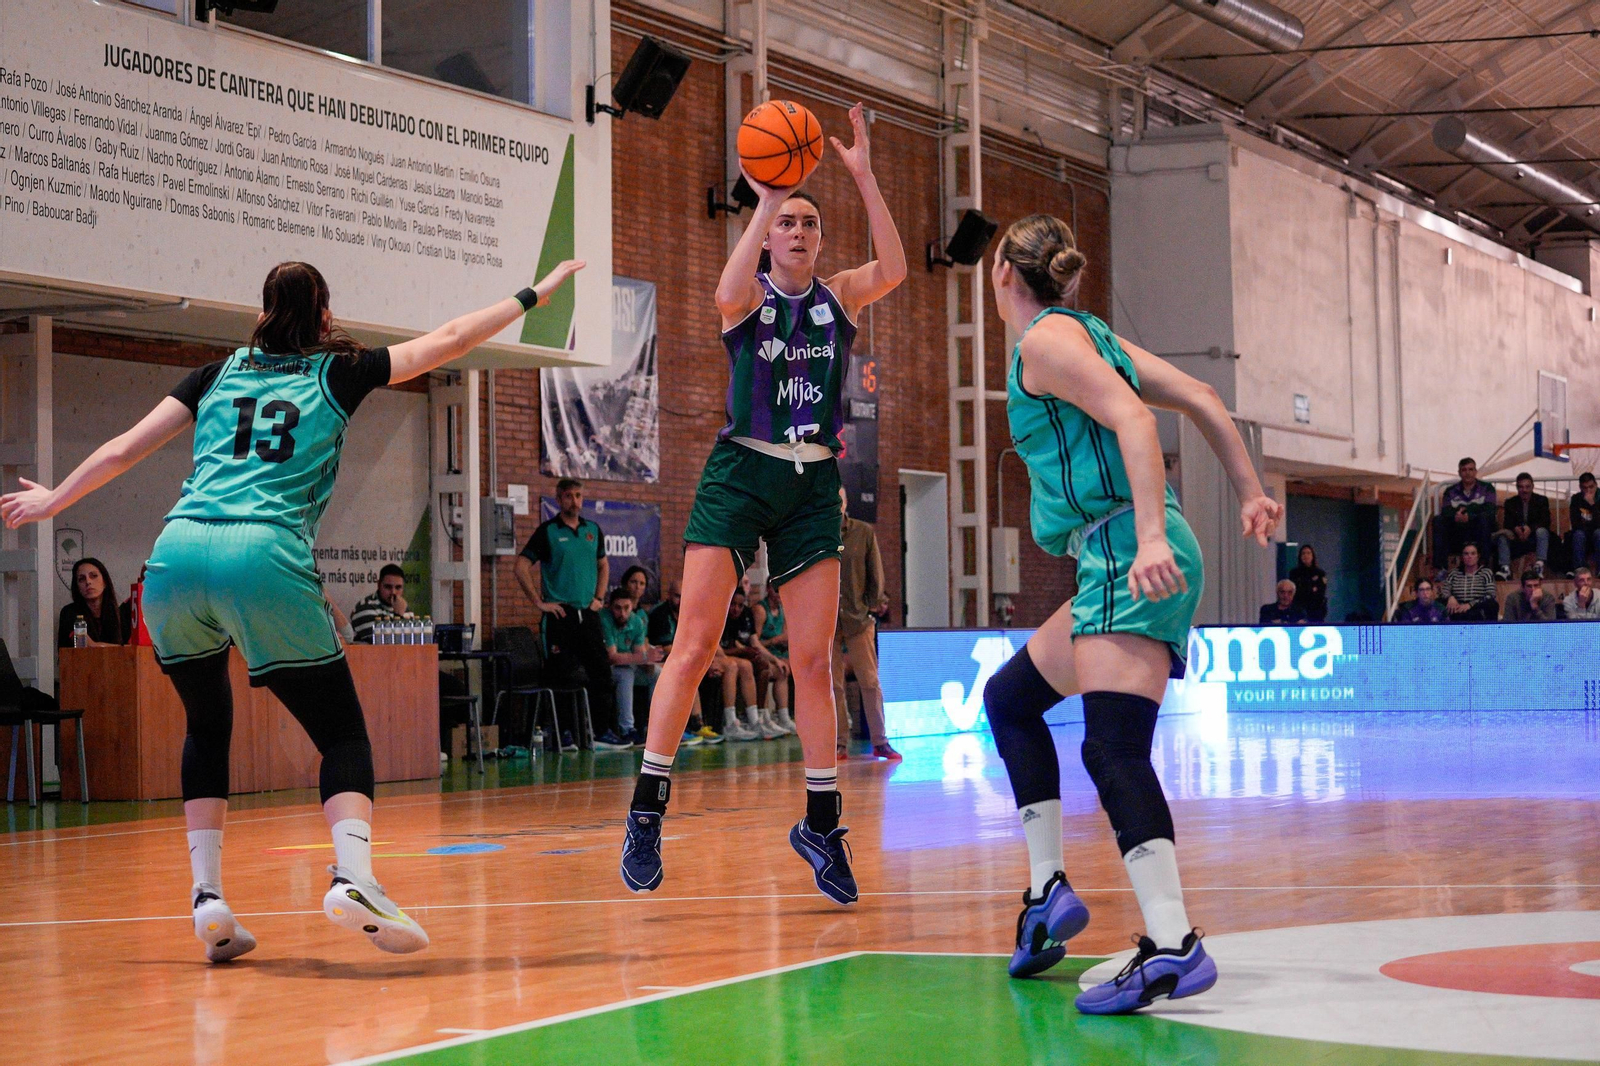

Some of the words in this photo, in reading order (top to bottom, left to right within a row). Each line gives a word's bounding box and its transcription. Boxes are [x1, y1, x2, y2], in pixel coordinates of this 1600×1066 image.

[0, 67, 21, 86] Rafa
[24, 72, 47, 92] Pozo
[55, 80, 76, 99] José
[79, 85, 111, 106] Antonio
[114, 92, 151, 115] Sánchez
[152, 101, 182, 121] Aranda
[190, 106, 212, 130] Ángel
[214, 112, 244, 135] Álvarez
[268, 126, 290, 145] Pedro
[325, 139, 356, 158] Armando
[358, 146, 384, 165] Nogués
[390, 154, 406, 168] Juan
[408, 157, 432, 174] Antonio
[480, 171, 500, 188] Osuna
[103, 44, 192, 84] JUGADORES
[197, 65, 216, 90] DE
[220, 71, 283, 105] CANTERA
[287, 88, 314, 112] QUE
[318, 95, 346, 120] HAN
[350, 102, 415, 135] DEBUTADO
[418, 118, 443, 141] CON
[446, 124, 459, 145] EL
[462, 128, 505, 155] PRIMER
[509, 139, 548, 165] EQUIPO
[0, 95, 29, 114] ntonio
[31, 99, 66, 123] Villegas
[74, 108, 115, 131] Fernando
[116, 117, 137, 136] Vidal
[145, 125, 177, 144] Juanma
[180, 130, 208, 150] Gómez
[214, 138, 234, 156] Jordi
[235, 142, 255, 160] Grau
[261, 148, 279, 164] Juan
[280, 152, 308, 171] Antonio
[310, 157, 328, 175] Rosa
[334, 163, 351, 179] José
[352, 166, 374, 186] Miguel
[376, 171, 408, 190] Cárdenas
[413, 180, 432, 195] Jesús
[433, 183, 455, 200] Lázaro
[460, 188, 483, 205] Manolo
[28, 123, 54, 143] Curro
[56, 126, 86, 150] Ávalos
[94, 136, 117, 159] Gaby
[120, 141, 139, 160] Ruiz
[147, 147, 174, 166] Nacho
[176, 152, 217, 176] Rodríguez
[224, 163, 254, 182] Antonio
[255, 166, 279, 187] Álamo
[286, 175, 314, 194] Ernesto
[316, 180, 345, 199] Serrano
[350, 187, 368, 203] Richi
[399, 196, 416, 213] Yuse
[444, 205, 463, 224] Fredy
[464, 209, 495, 227] Navarrete
[5, 195, 24, 214] Pino
[32, 200, 74, 221] Baboucar
[76, 207, 97, 229] Badji
[10, 169, 44, 192] Ognjen
[47, 176, 81, 197] Kuzmic
[90, 184, 120, 204] Maodo
[123, 190, 162, 211] Nguirane
[170, 197, 199, 218] Domas
[202, 203, 235, 223] Sabonis
[242, 210, 275, 230] Romaric
[277, 217, 315, 237] Belemene
[321, 224, 333, 240] Mo
[335, 227, 365, 245] Soluade
[371, 234, 387, 252] Viny
[416, 241, 442, 257] Cristian
[444, 246, 456, 260] Uta
[462, 249, 485, 266] Ignacio
[486, 252, 502, 268] Rosa
[14, 145, 48, 167] Marcos
[51, 152, 90, 174] Baltanás
[98, 161, 119, 180] Rafa
[121, 166, 155, 186] Huertas
[162, 173, 185, 192] Pavel
[188, 178, 229, 199] Ermolinski
[236, 188, 265, 206] Alfonso
[267, 193, 300, 213] Sánchez
[306, 200, 323, 216] Vitor
[325, 203, 356, 222] Faverani
[362, 210, 382, 227] Pablo
[383, 215, 407, 232] Movilla
[412, 219, 436, 237] Paulao
[437, 224, 462, 241] Prestes
[784, 341, 836, 362] Unicaj
[776, 376, 824, 410] Mijas
[232, 396, 300, 464] 13
[341, 545, 359, 561] más
[362, 550, 377, 563] que
[380, 546, 387, 561] la
[604, 534, 638, 557] oma
[328, 568, 346, 583] más
[349, 572, 364, 586] que
[367, 569, 378, 583] de
[1186, 626, 1344, 682] oma
[1235, 689, 1275, 702] YOUR
[1282, 687, 1355, 702] FREEDOM
